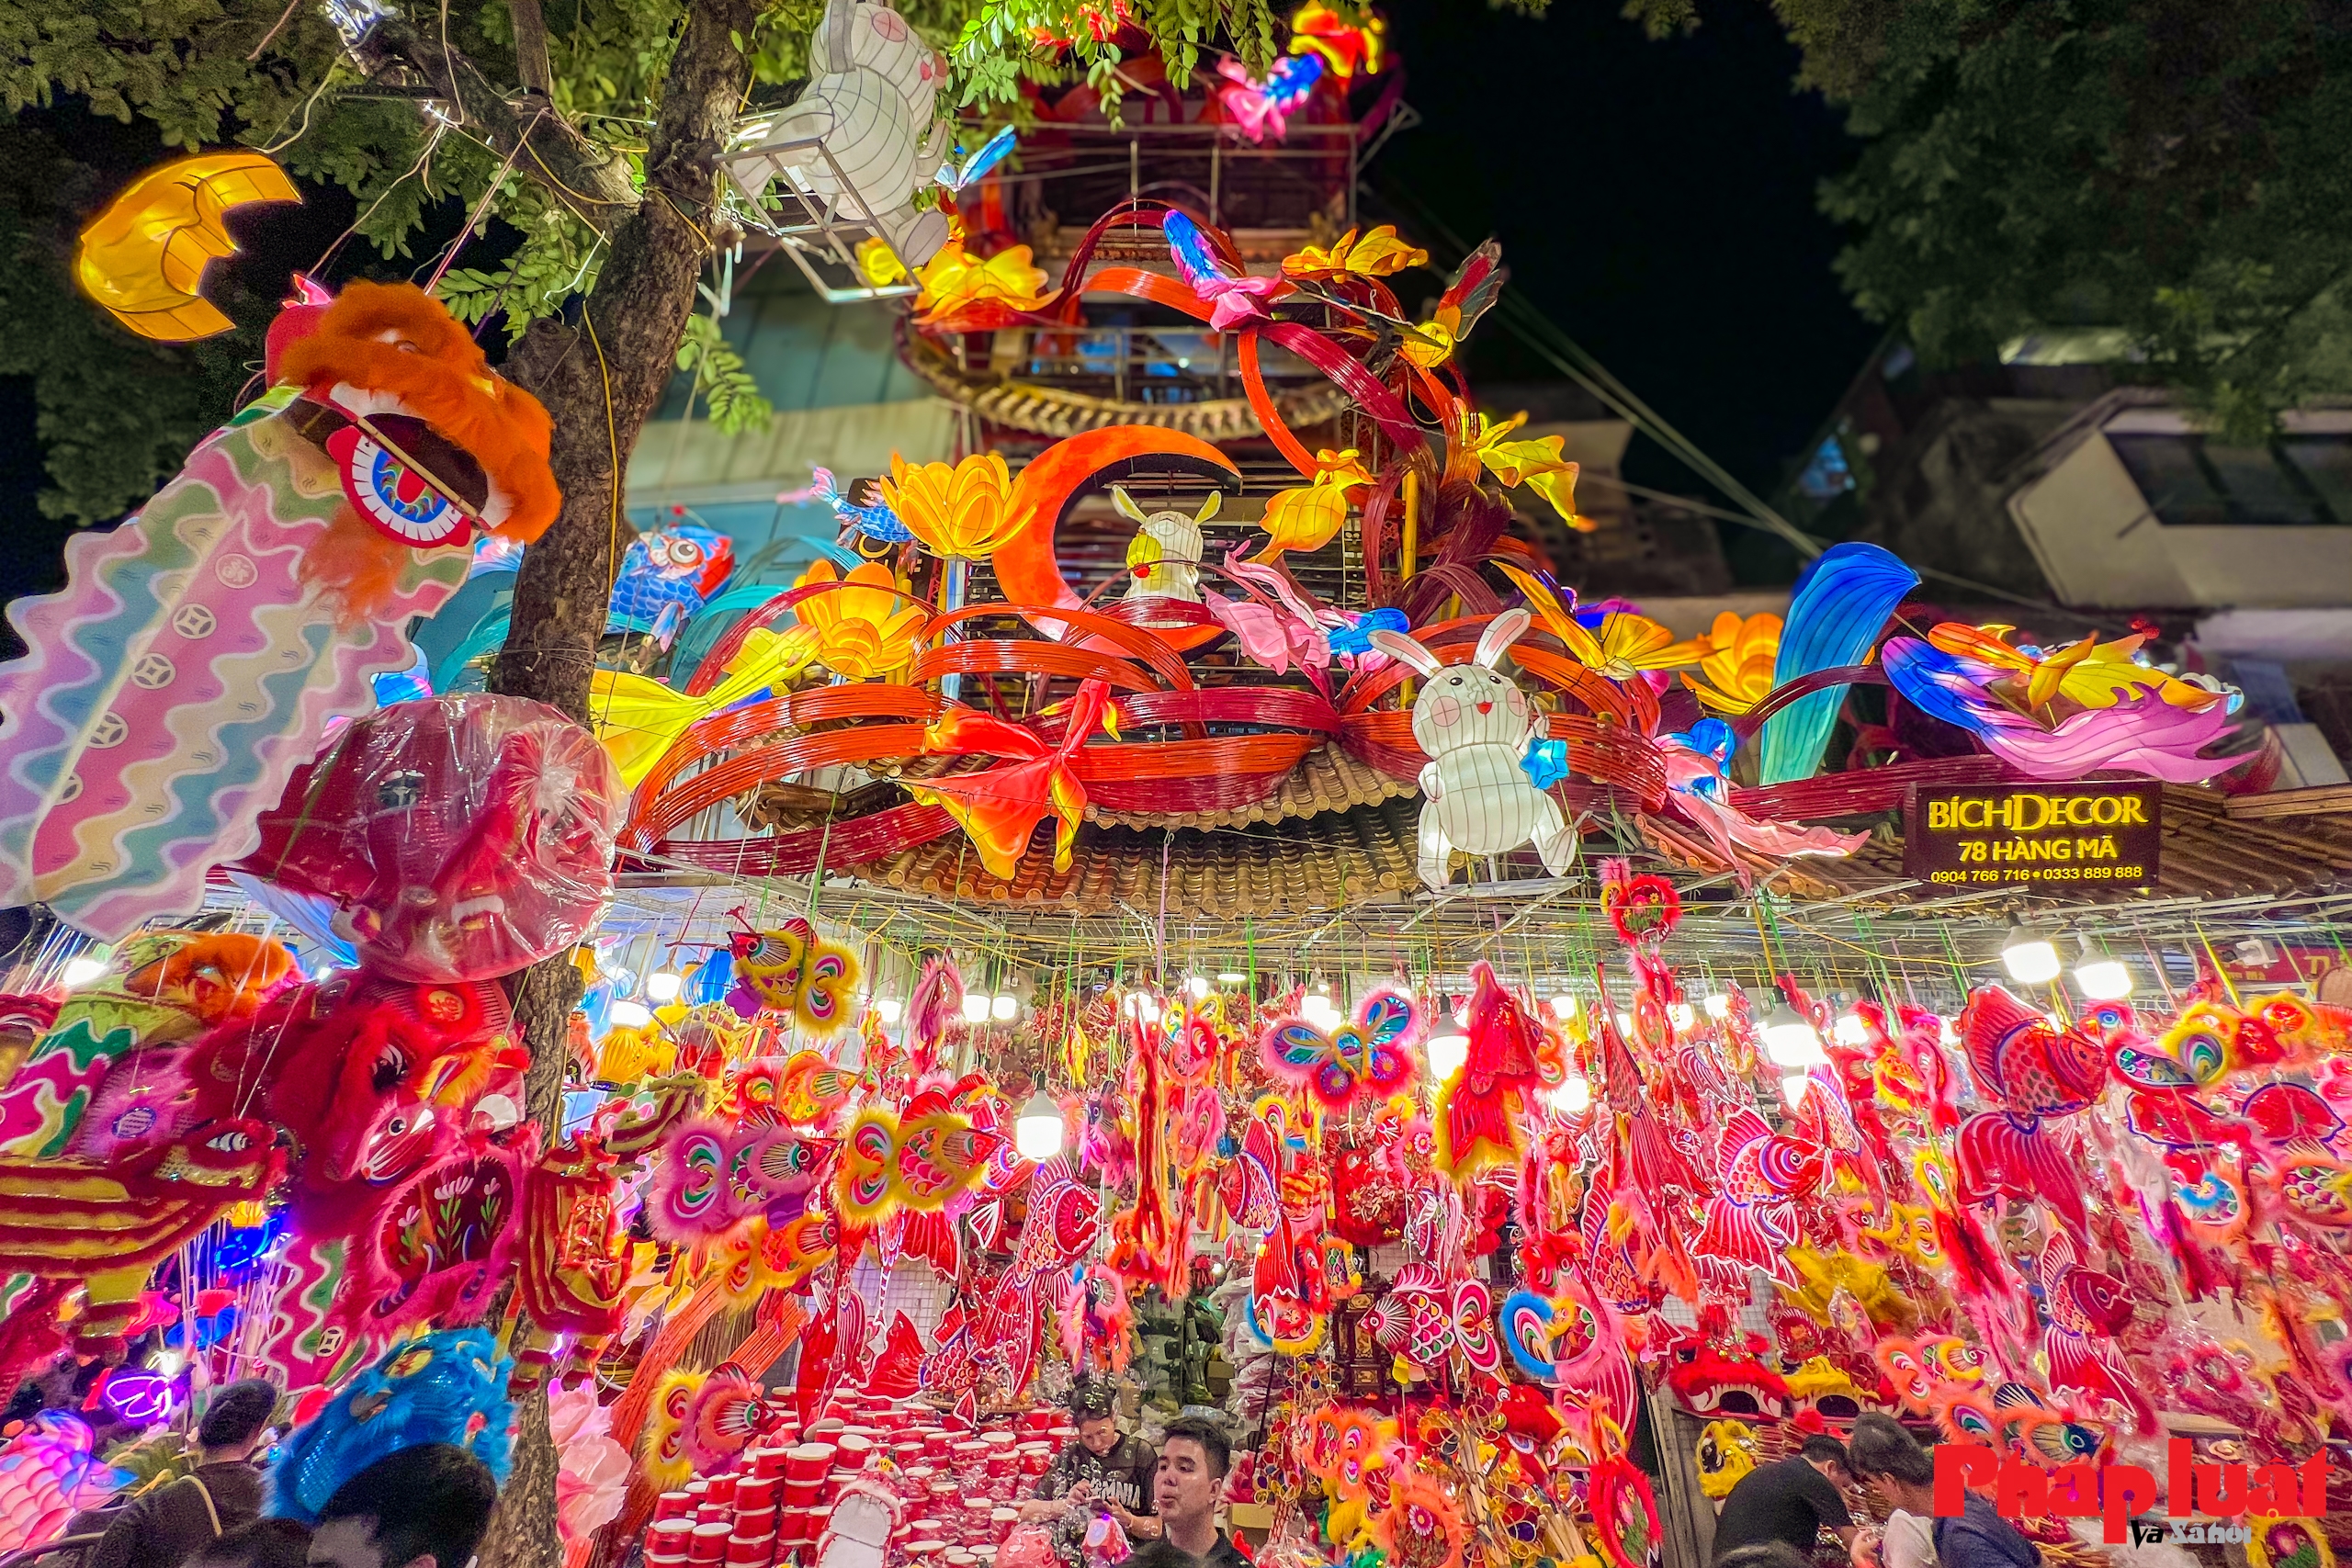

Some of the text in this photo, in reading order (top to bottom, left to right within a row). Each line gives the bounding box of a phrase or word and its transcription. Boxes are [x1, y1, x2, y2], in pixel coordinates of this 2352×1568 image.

[1958, 834, 2118, 862] 78 HÀNG MÃ
[1930, 871, 1967, 883] 0904
[1971, 870, 1999, 882] 766
[2083, 867, 2111, 879] 889
[2114, 866, 2143, 878] 888
